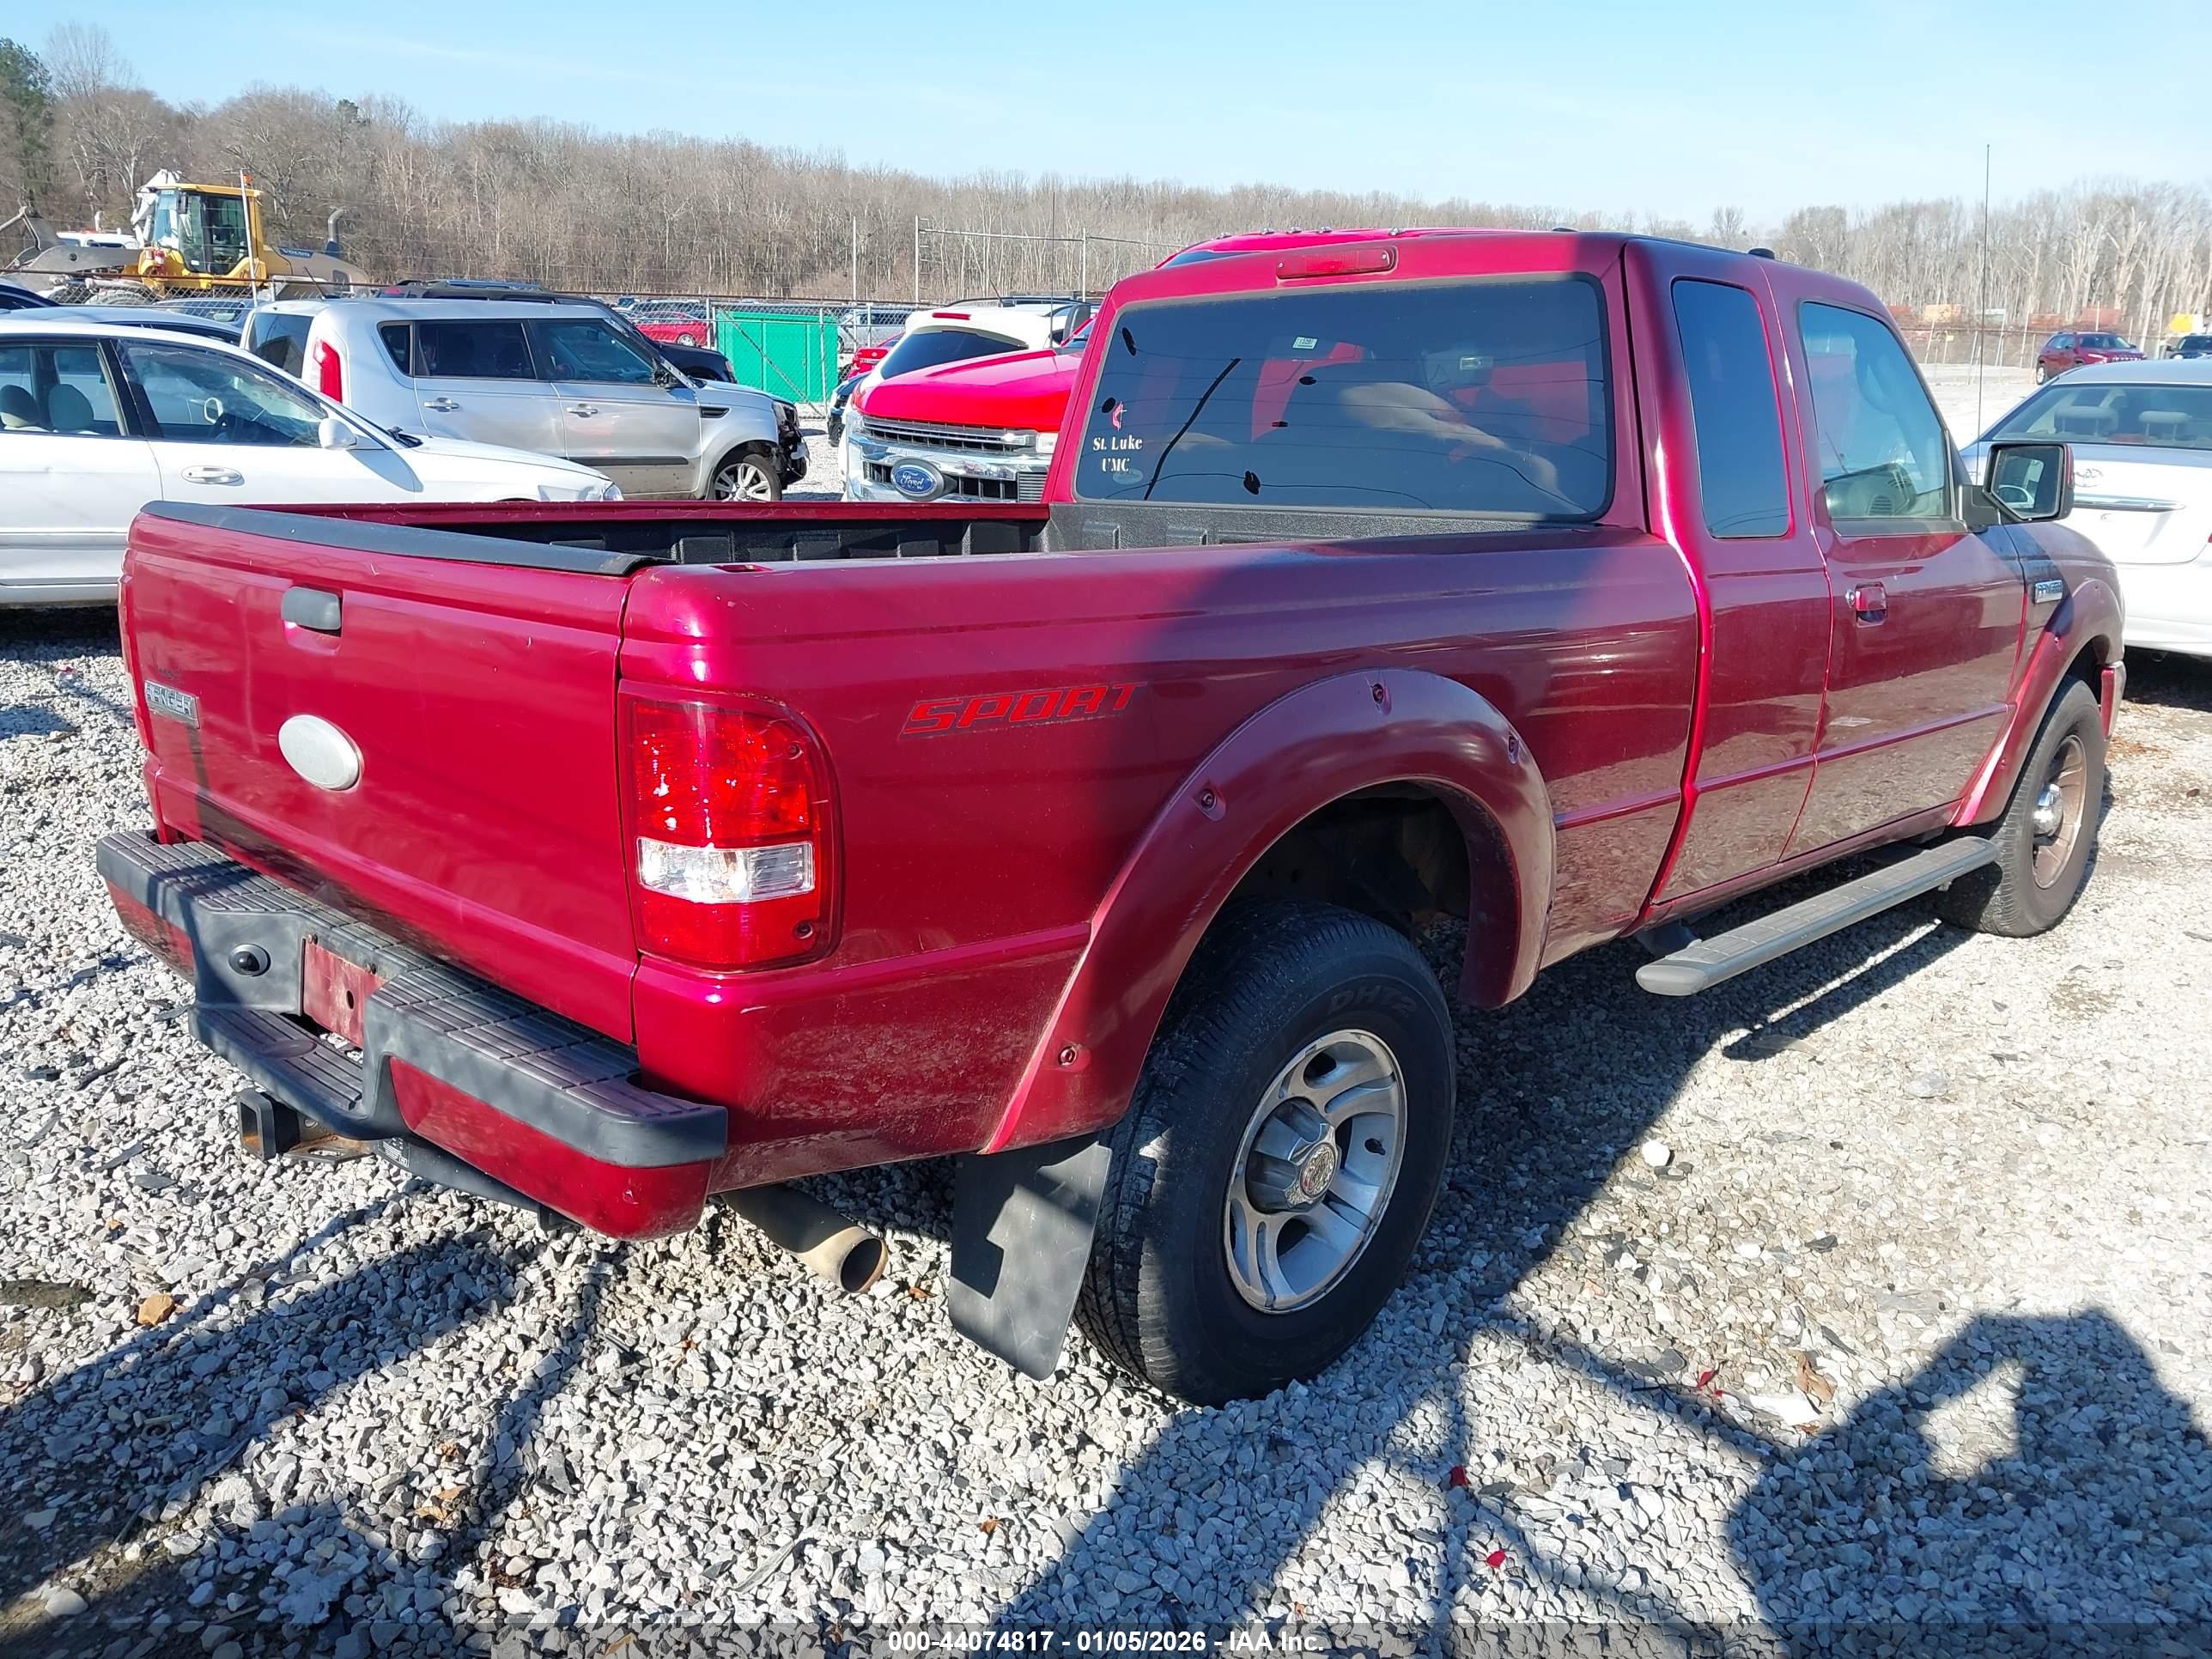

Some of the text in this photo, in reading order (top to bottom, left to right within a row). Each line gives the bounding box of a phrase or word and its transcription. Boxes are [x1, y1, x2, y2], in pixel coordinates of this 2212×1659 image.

[1092, 434, 1143, 451] St. Luke
[1102, 457, 1130, 472] UMC
[900, 471, 925, 489] Ford
[902, 683, 1140, 734] SPORT
